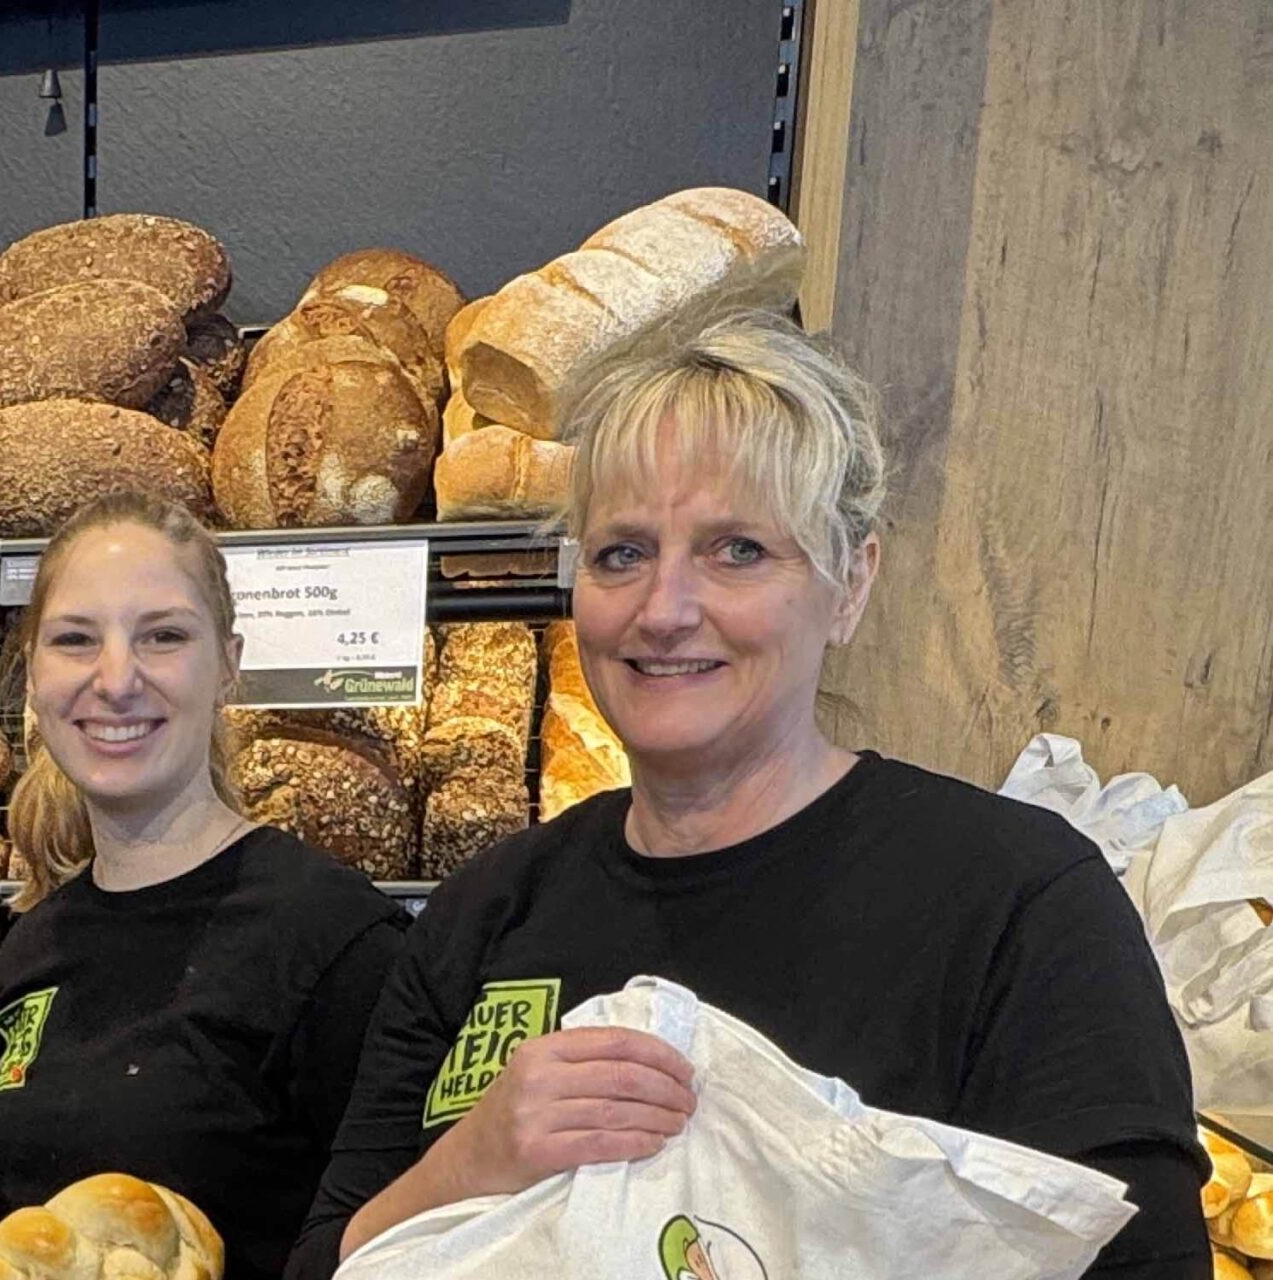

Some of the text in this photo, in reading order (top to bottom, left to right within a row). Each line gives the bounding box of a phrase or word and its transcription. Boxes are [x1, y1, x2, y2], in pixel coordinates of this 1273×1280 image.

[304, 586, 338, 600] 500g
[337, 631, 380, 645] 4,25 €
[344, 677, 414, 694] Grünewald
